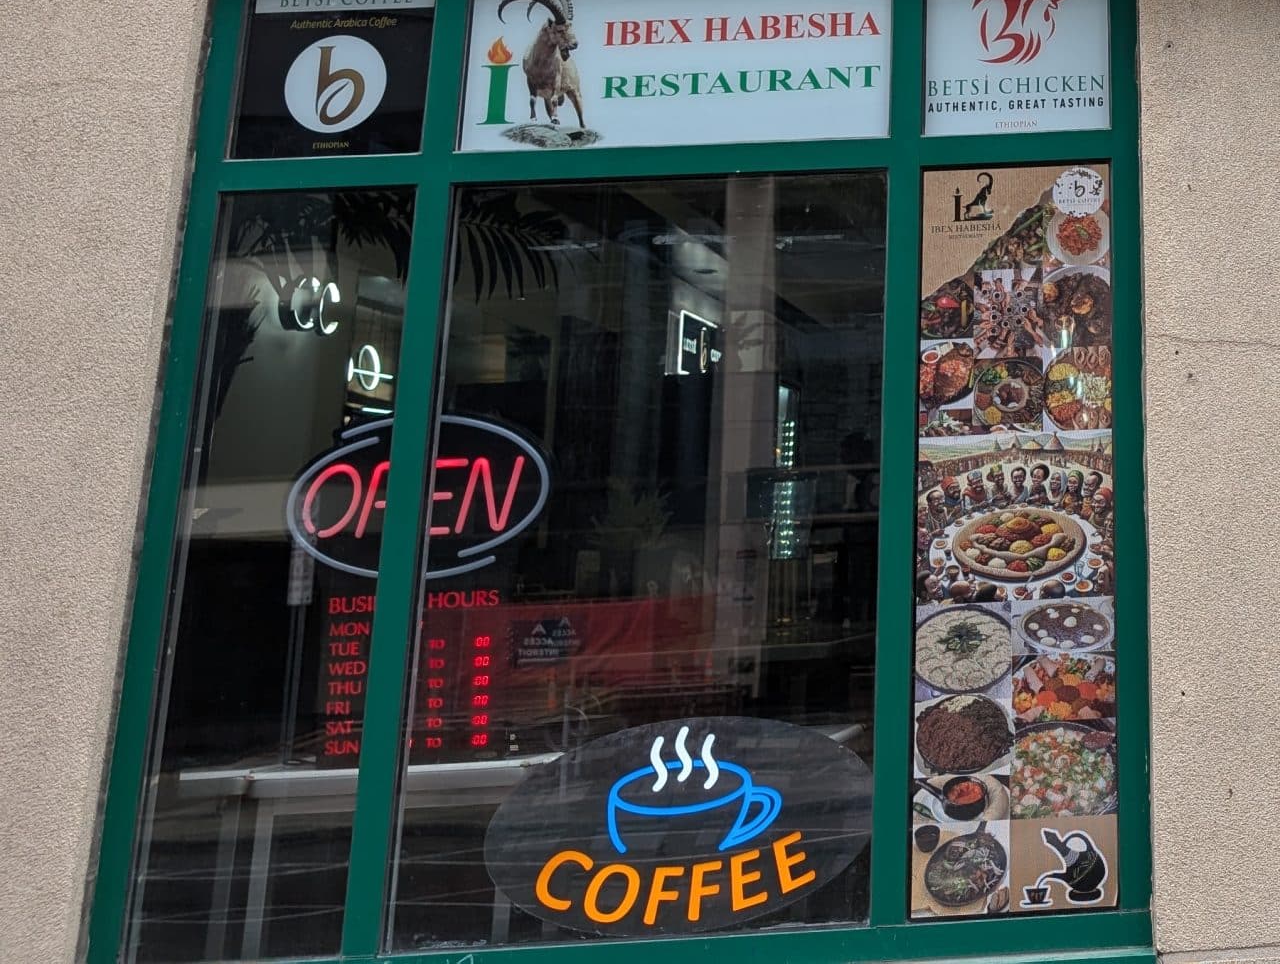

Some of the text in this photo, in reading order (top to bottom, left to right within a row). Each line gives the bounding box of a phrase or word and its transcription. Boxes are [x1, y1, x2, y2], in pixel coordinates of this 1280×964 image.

[290, 15, 398, 29] Authentic Arabica Coffee
[602, 11, 881, 47] IBEX HABESHA
[601, 65, 881, 99] RESTAURANT
[998, 75, 1104, 95] CHICKEN
[928, 96, 1104, 113] AUTHENTIC, GREAT TASTING
[428, 590, 499, 608] HOURS
[329, 622, 370, 636] MON
[329, 642, 360, 656] TUE
[328, 661, 366, 676] WED
[328, 681, 362, 694] THU
[326, 701, 350, 715] FRI
[325, 720, 353, 735] SAT
[324, 740, 359, 755] SUN
[535, 831, 816, 925] COFFEE
